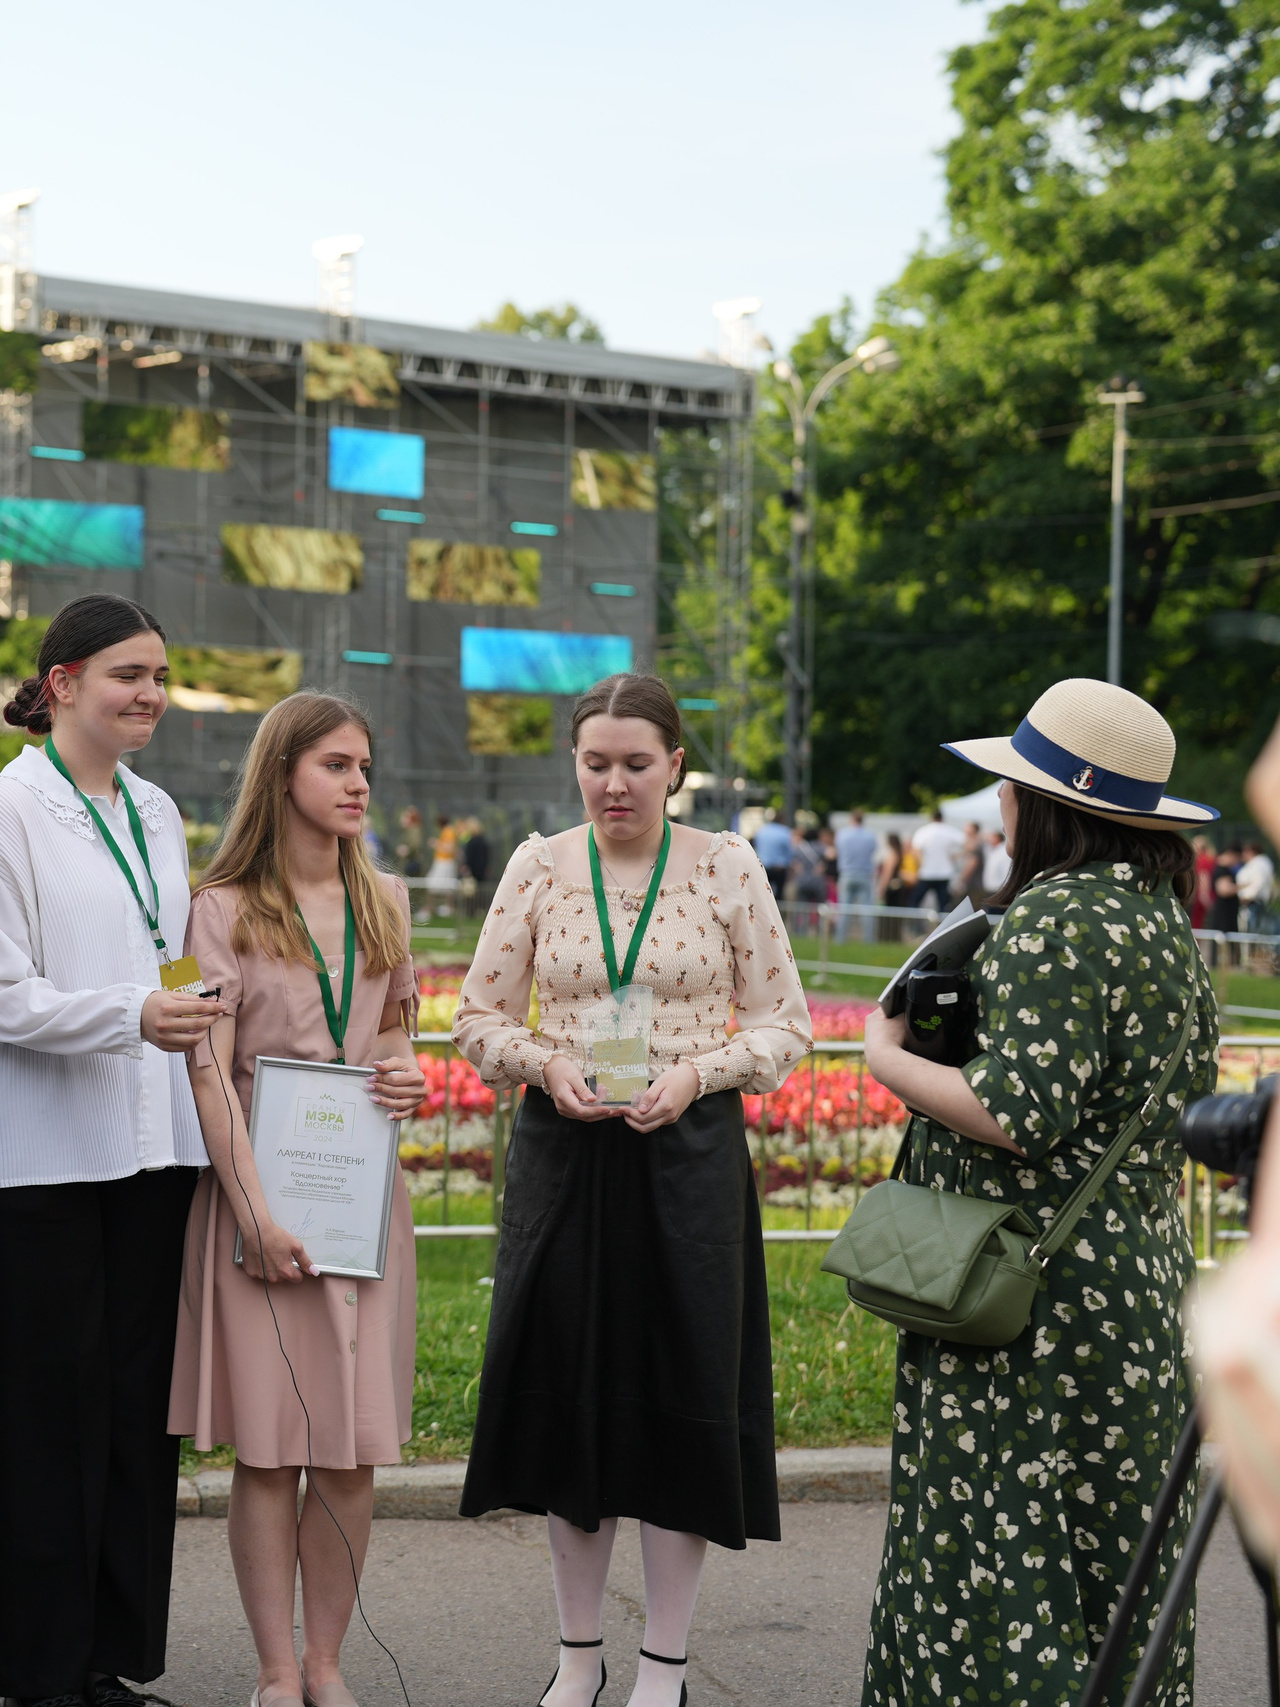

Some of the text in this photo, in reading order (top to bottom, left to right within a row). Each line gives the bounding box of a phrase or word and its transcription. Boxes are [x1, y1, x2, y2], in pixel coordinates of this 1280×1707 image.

[306, 1103, 345, 1114] ГРАНТЫ
[305, 1110, 344, 1124] МЭРА
[304, 1121, 344, 1132] МОСКВЫ
[314, 1135, 333, 1143] 2024
[276, 1149, 316, 1160] ЛАУРЕАТ
[323, 1153, 365, 1166] СТЕПЕНИ
[290, 1171, 333, 1182] Концертный
